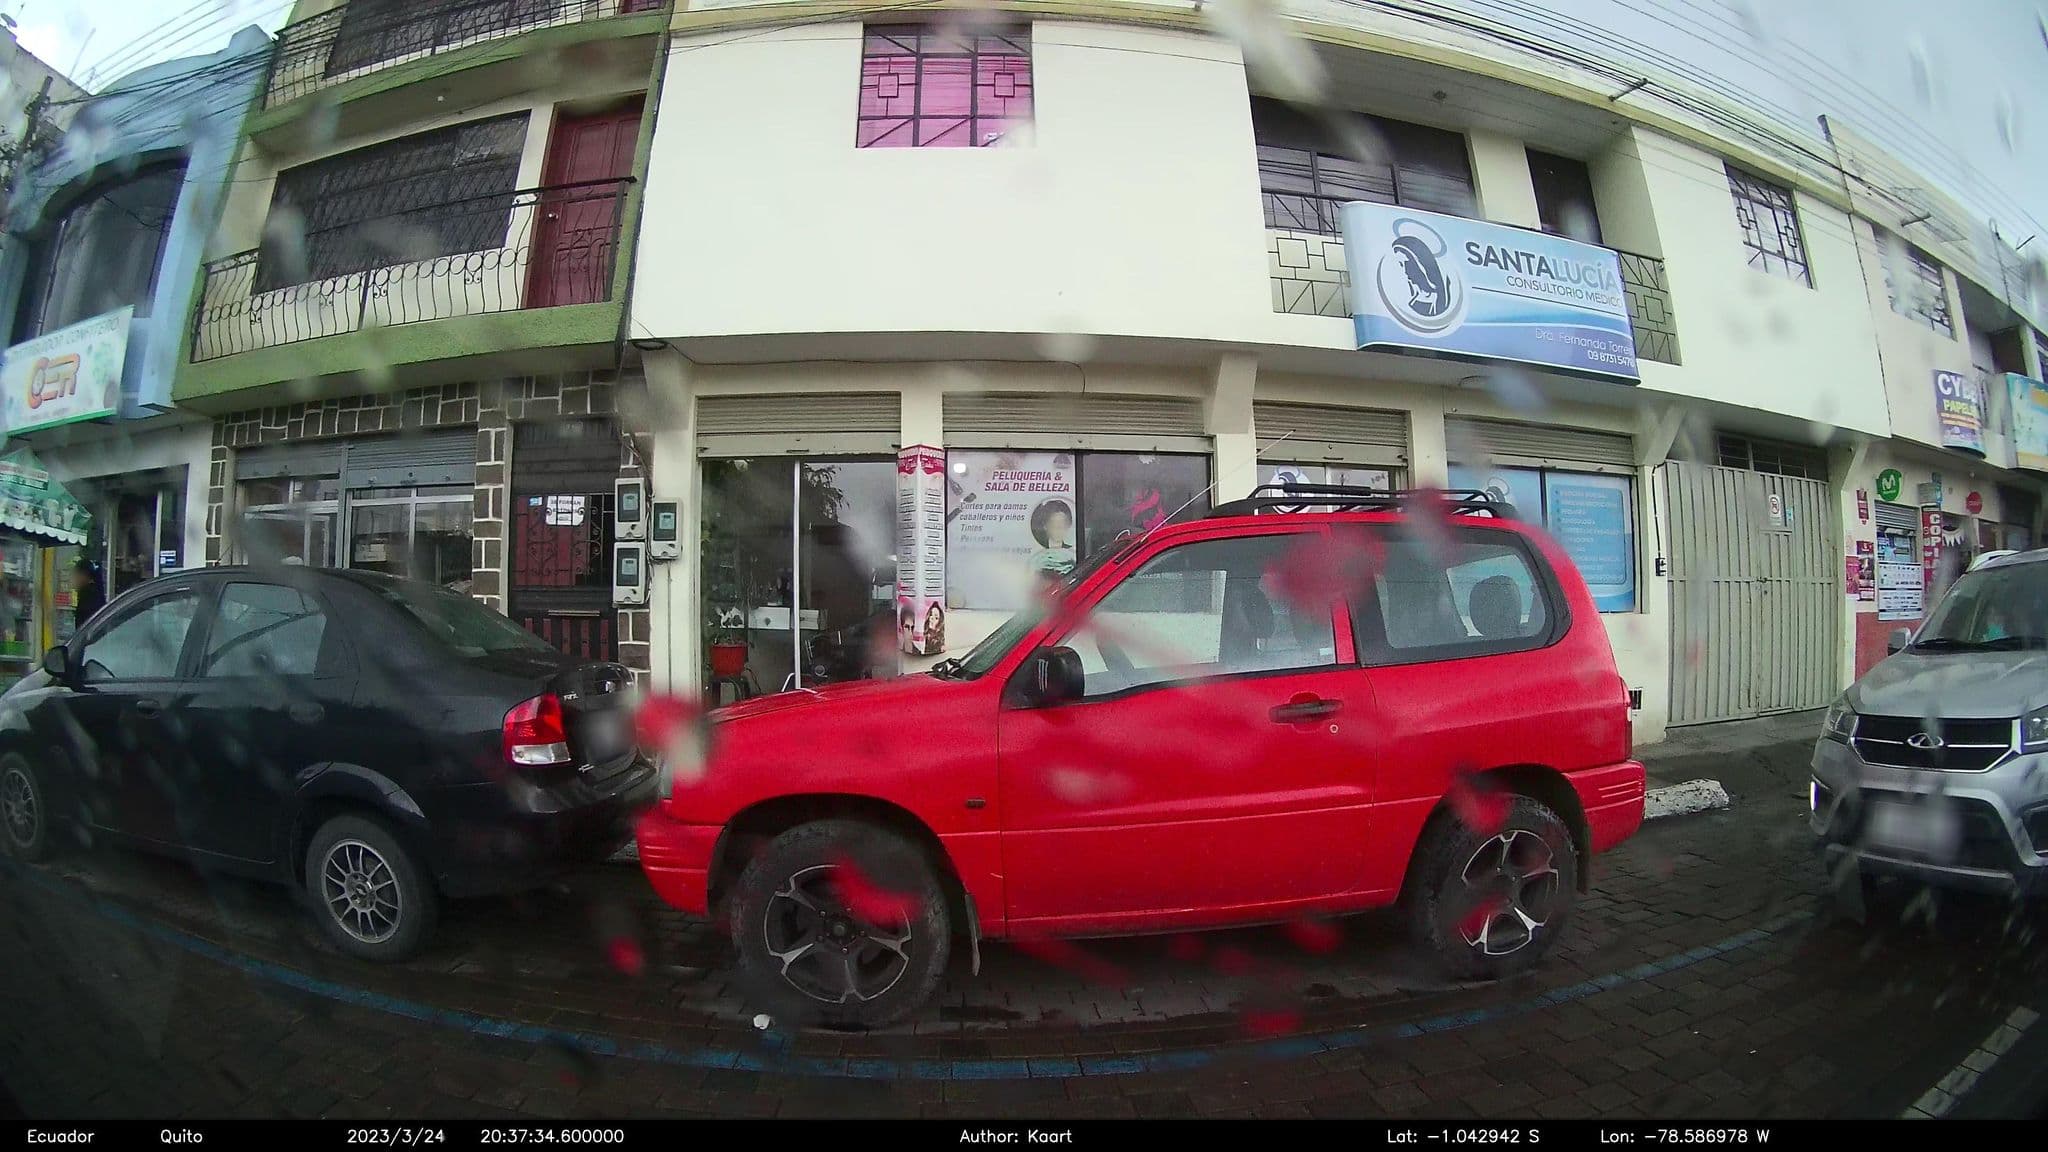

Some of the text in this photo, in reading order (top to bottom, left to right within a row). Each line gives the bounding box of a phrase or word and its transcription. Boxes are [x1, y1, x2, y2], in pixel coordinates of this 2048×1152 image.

[1506, 275, 1584, 299] CONSULTORIO
[1560, 332, 1606, 350] Fernanda
[1054, 471, 1063, 481] &
[984, 482, 1070, 492] SALA DE BELLEZA
